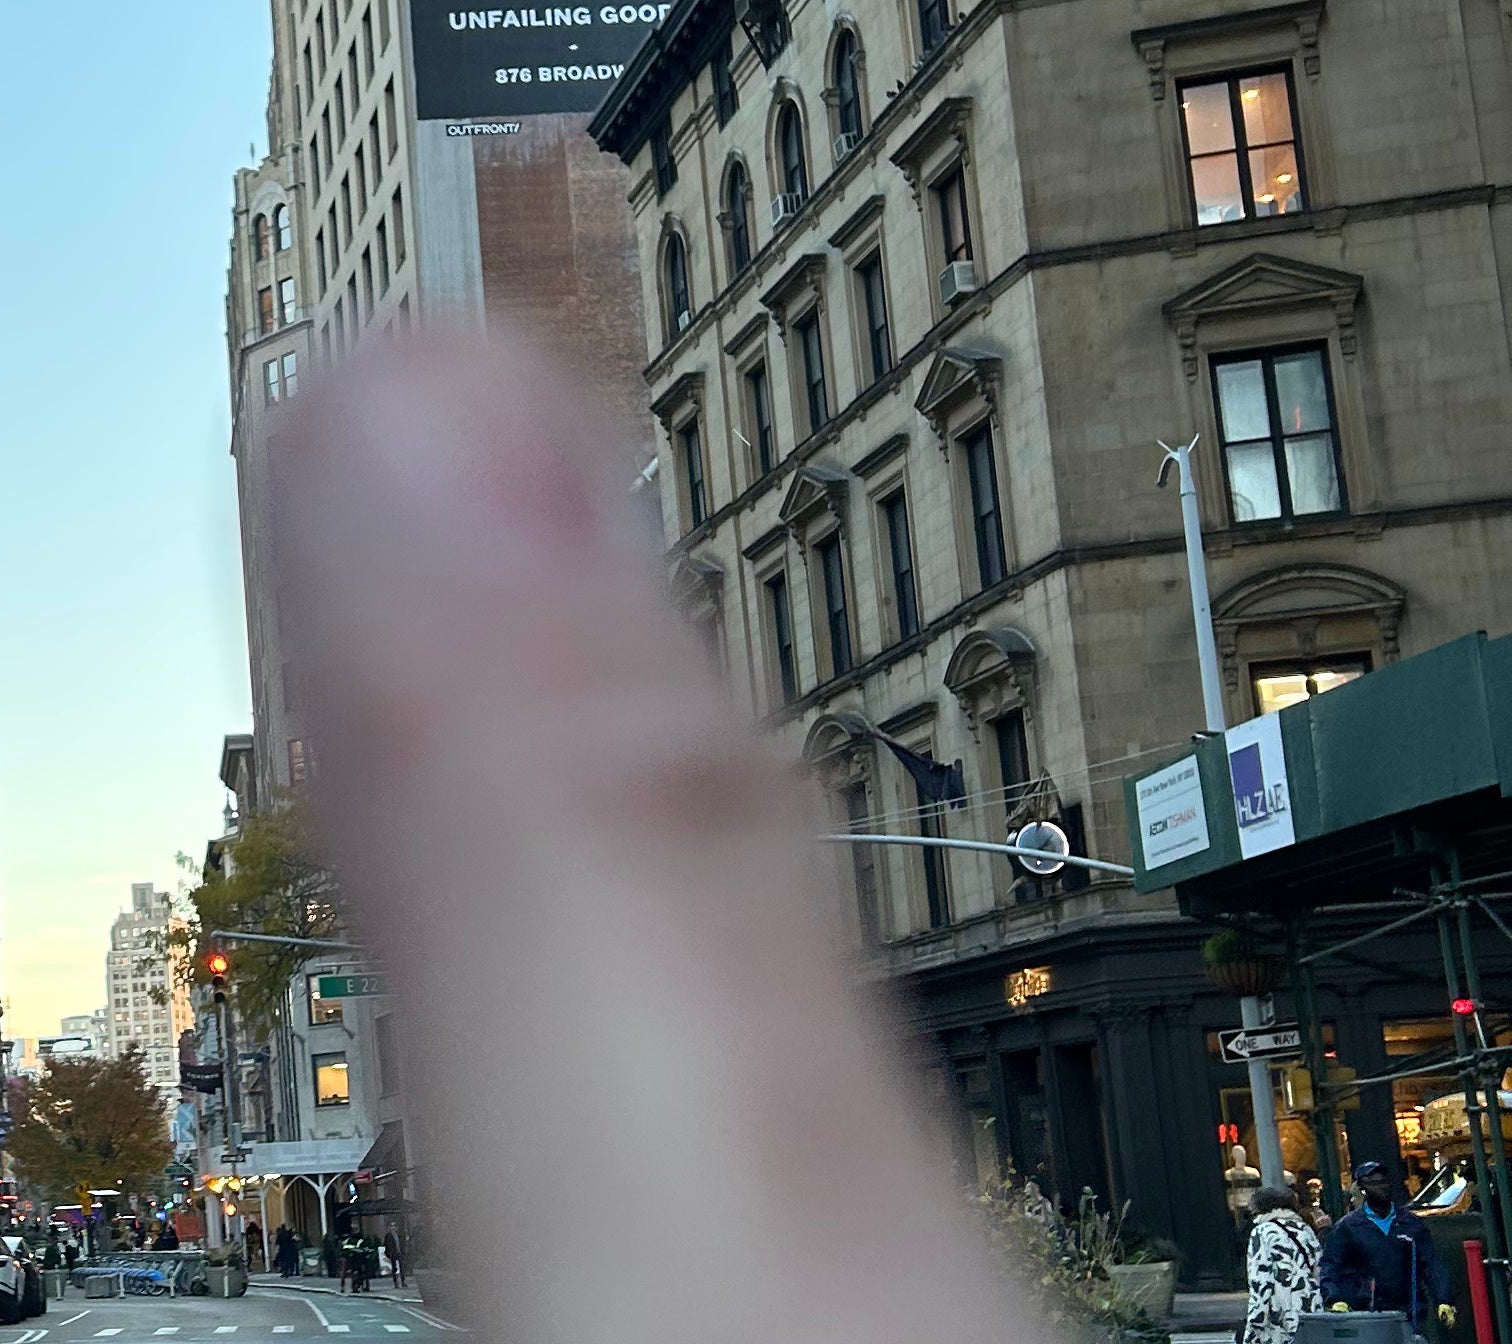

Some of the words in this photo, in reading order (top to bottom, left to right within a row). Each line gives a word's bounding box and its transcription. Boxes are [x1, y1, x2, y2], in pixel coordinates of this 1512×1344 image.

[448, 6, 593, 31] UNFAILING
[494, 67, 533, 85] 876
[346, 978, 354, 994] E
[1234, 1037, 1260, 1051] ONE
[1272, 1032, 1296, 1046] WAY
